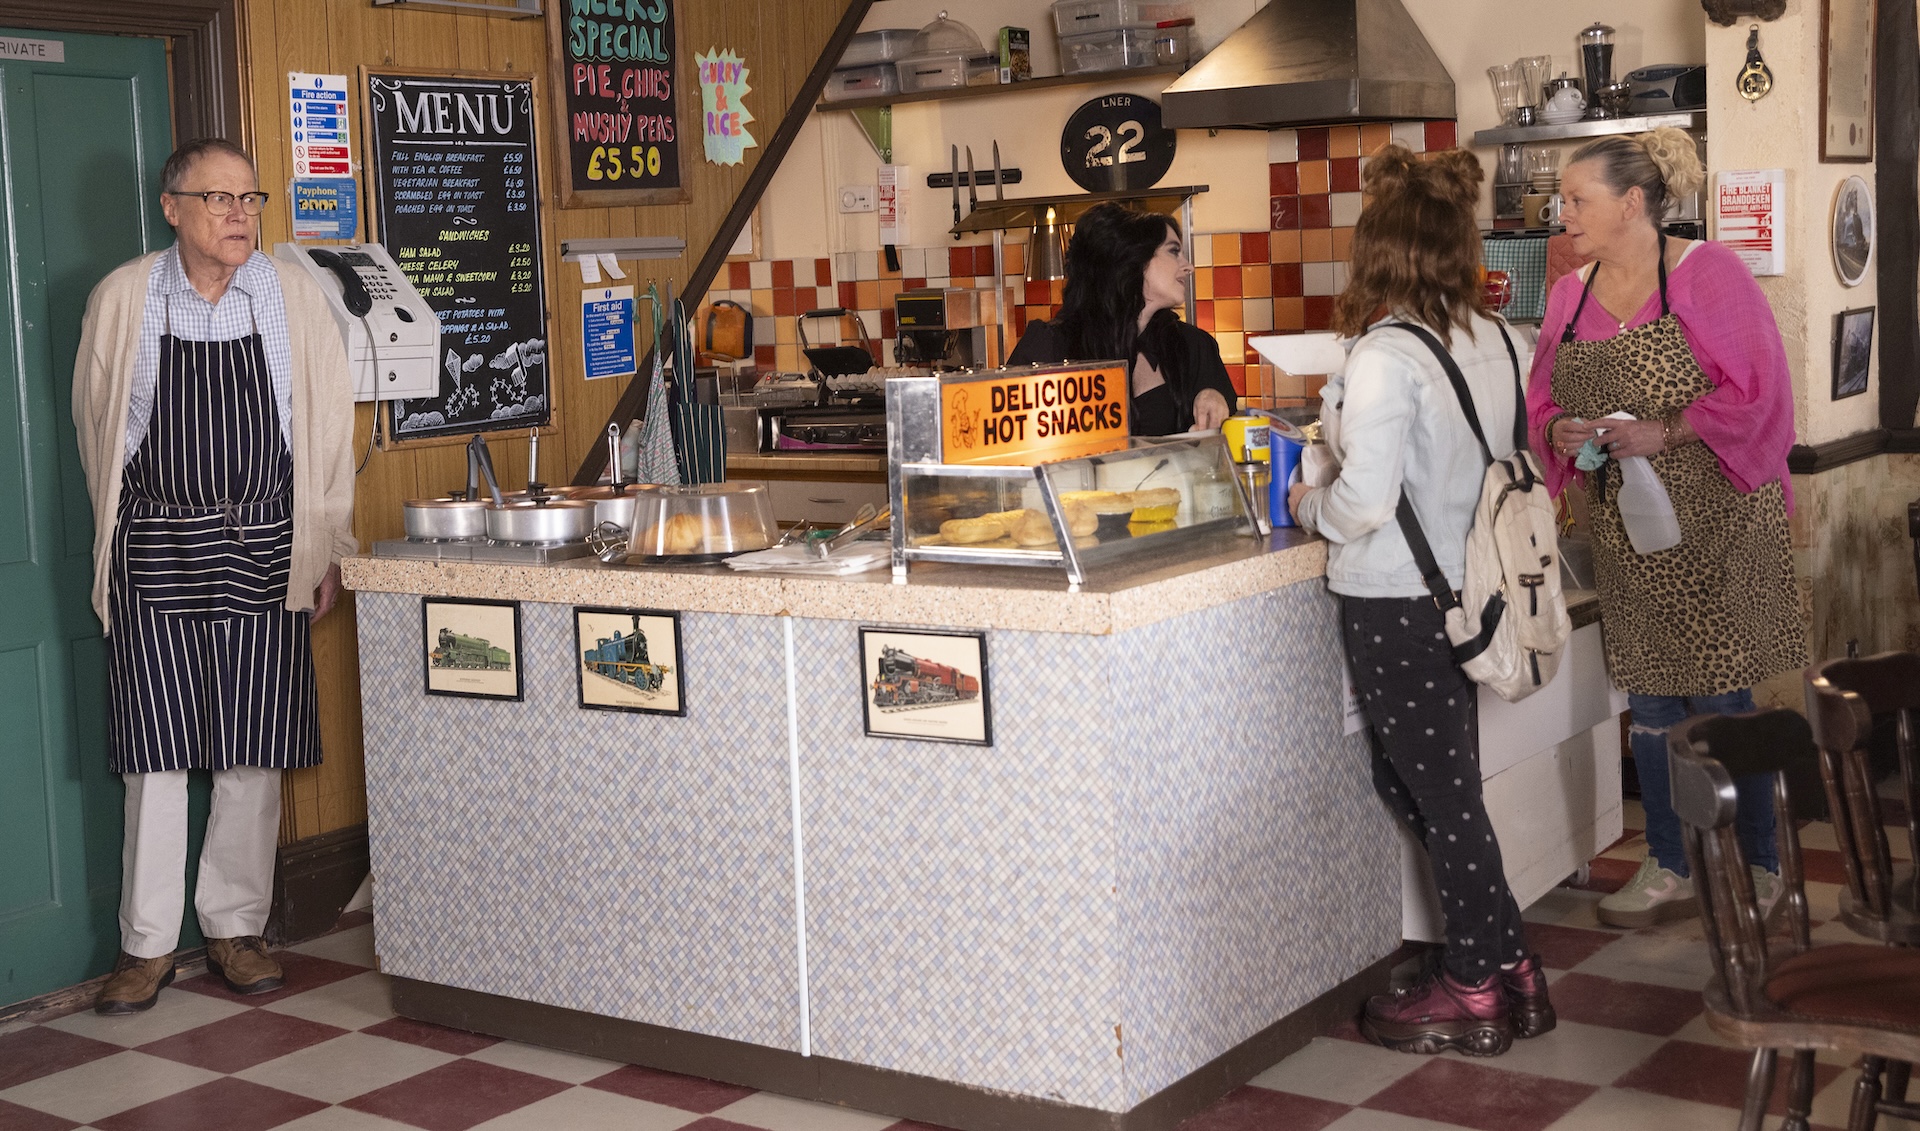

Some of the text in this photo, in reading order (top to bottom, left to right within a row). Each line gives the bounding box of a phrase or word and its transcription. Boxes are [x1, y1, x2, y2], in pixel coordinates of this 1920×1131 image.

[571, 15, 667, 60] SPECIAL
[0, 41, 46, 57] RIVATE
[701, 59, 742, 85] CURRY
[621, 68, 671, 100] CHIPS
[301, 90, 336, 99] Fire action
[715, 85, 728, 112] &
[621, 99, 629, 113] &
[1102, 97, 1131, 108] LNER
[392, 90, 514, 134] MENU
[574, 111, 674, 144] MUSHY PEAS
[707, 112, 741, 136] RICE
[1084, 120, 1147, 168] 22
[391, 151, 409, 161] FULL
[414, 152, 443, 162] ENGLISH
[587, 145, 661, 180] £5.50
[392, 165, 409, 174] WITH
[412, 165, 425, 174] TEA
[428, 166, 436, 174] OR
[439, 165, 463, 174] COFFEE
[393, 178, 438, 187] VEGETARIAN
[442, 178, 480, 187] BREAKFAST
[1722, 183, 1770, 195] FIRE BLANKET
[297, 185, 337, 198] Payphone
[394, 189, 526, 200] SCRAMBLED EGG ON TOAST £3.50
[1722, 194, 1770, 205] BRANDDEKEN
[395, 202, 527, 214] POACHED EGG ON TOAST £3.50
[438, 230, 490, 241] SANDWICHES
[399, 243, 530, 258] HAM SALAD £3.20
[399, 257, 531, 271] CHEESE CELERY £2.50
[406, 274, 419, 284] NA
[423, 273, 445, 283] MAYO
[446, 273, 453, 283] &
[455, 271, 498, 282] SWEETCORN
[432, 286, 455, 296] SALAD
[511, 282, 532, 293] £3.20
[593, 301, 622, 312] First aid
[435, 308, 505, 320] KET POTATOES WITH
[440, 324, 469, 334] OPPINGS
[478, 323, 484, 331] A
[485, 321, 511, 330] SALAD.
[465, 333, 491, 344] £5.20
[991, 374, 1106, 413] DELICIOUS
[983, 402, 1122, 446] HOT SNACKS
